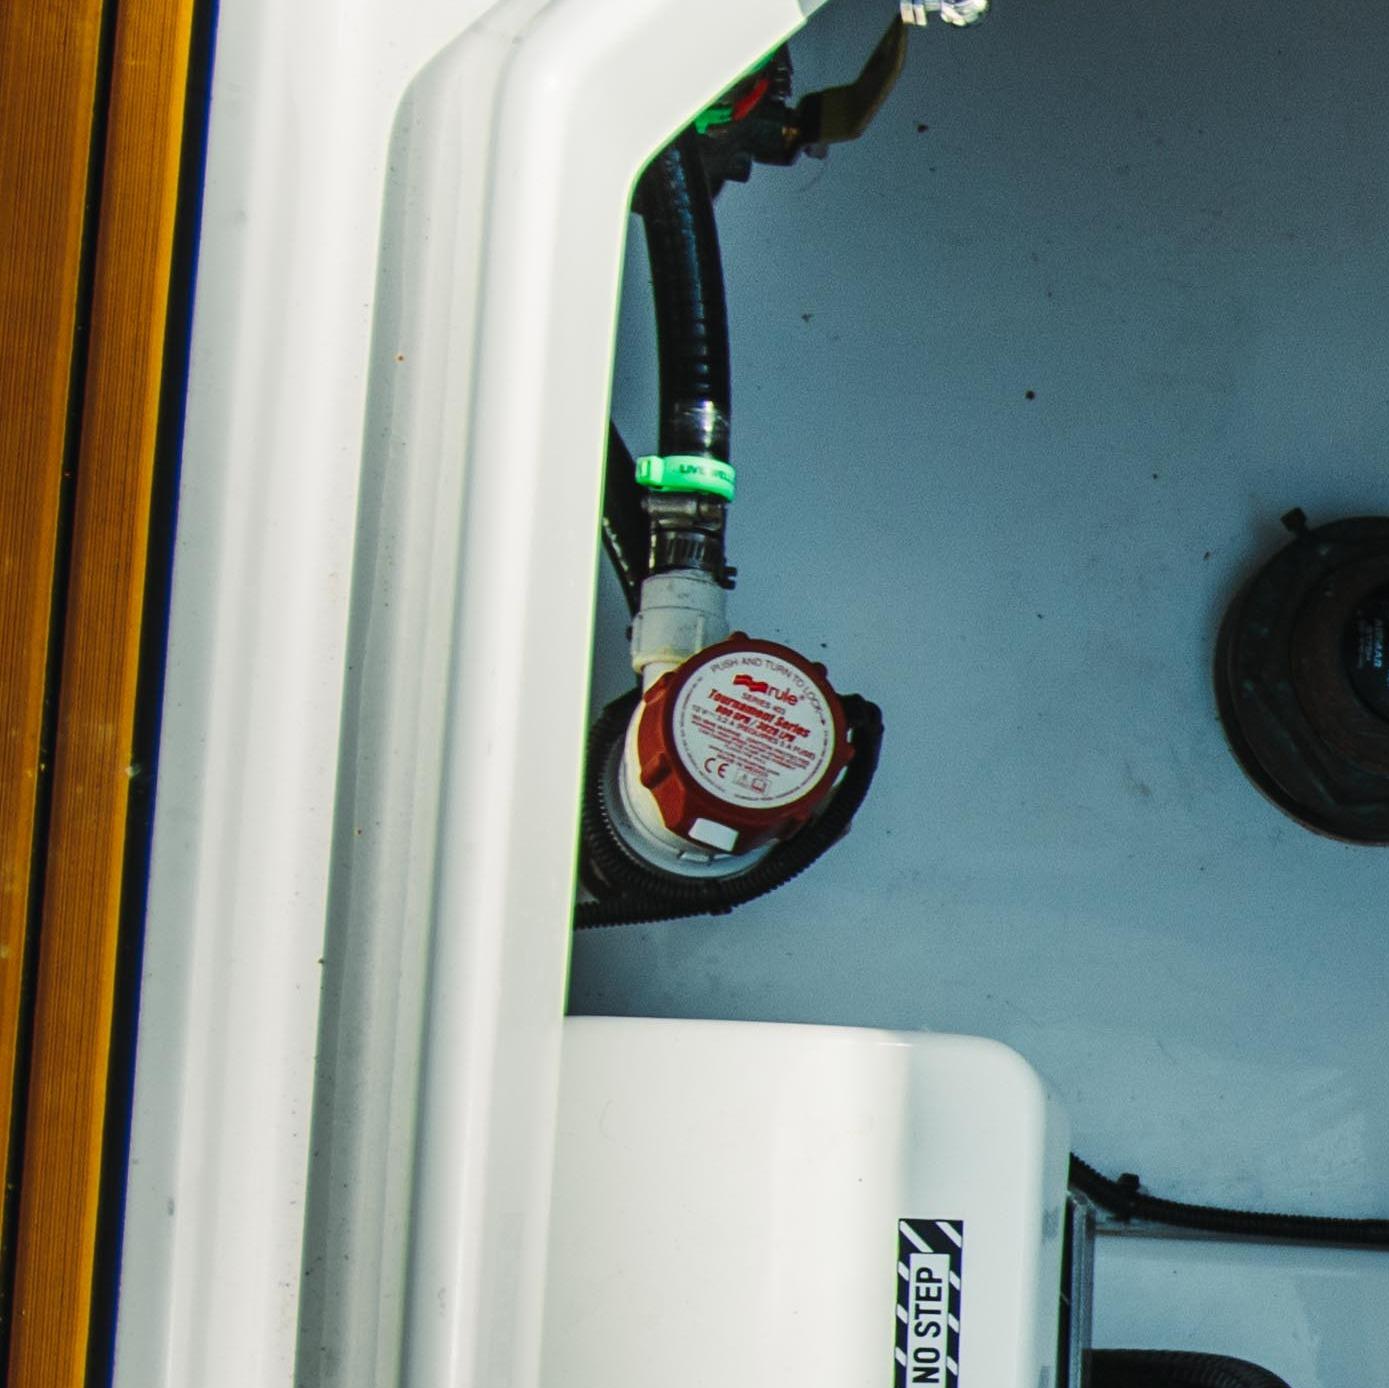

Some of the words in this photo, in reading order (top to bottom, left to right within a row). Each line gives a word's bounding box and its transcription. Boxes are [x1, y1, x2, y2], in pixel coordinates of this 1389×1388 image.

[710, 659, 738, 672] PUSH
[742, 657, 762, 667] AND
[765, 660, 792, 678] TURN
[794, 675, 804, 688] TO
[804, 686, 823, 713] LOCK
[741, 692, 771, 709] SERIES
[709, 688, 775, 721] Tournament
[774, 717, 811, 738] Series
[914, 1266, 943, 1338] STEP
[912, 1347, 941, 1384] NO
